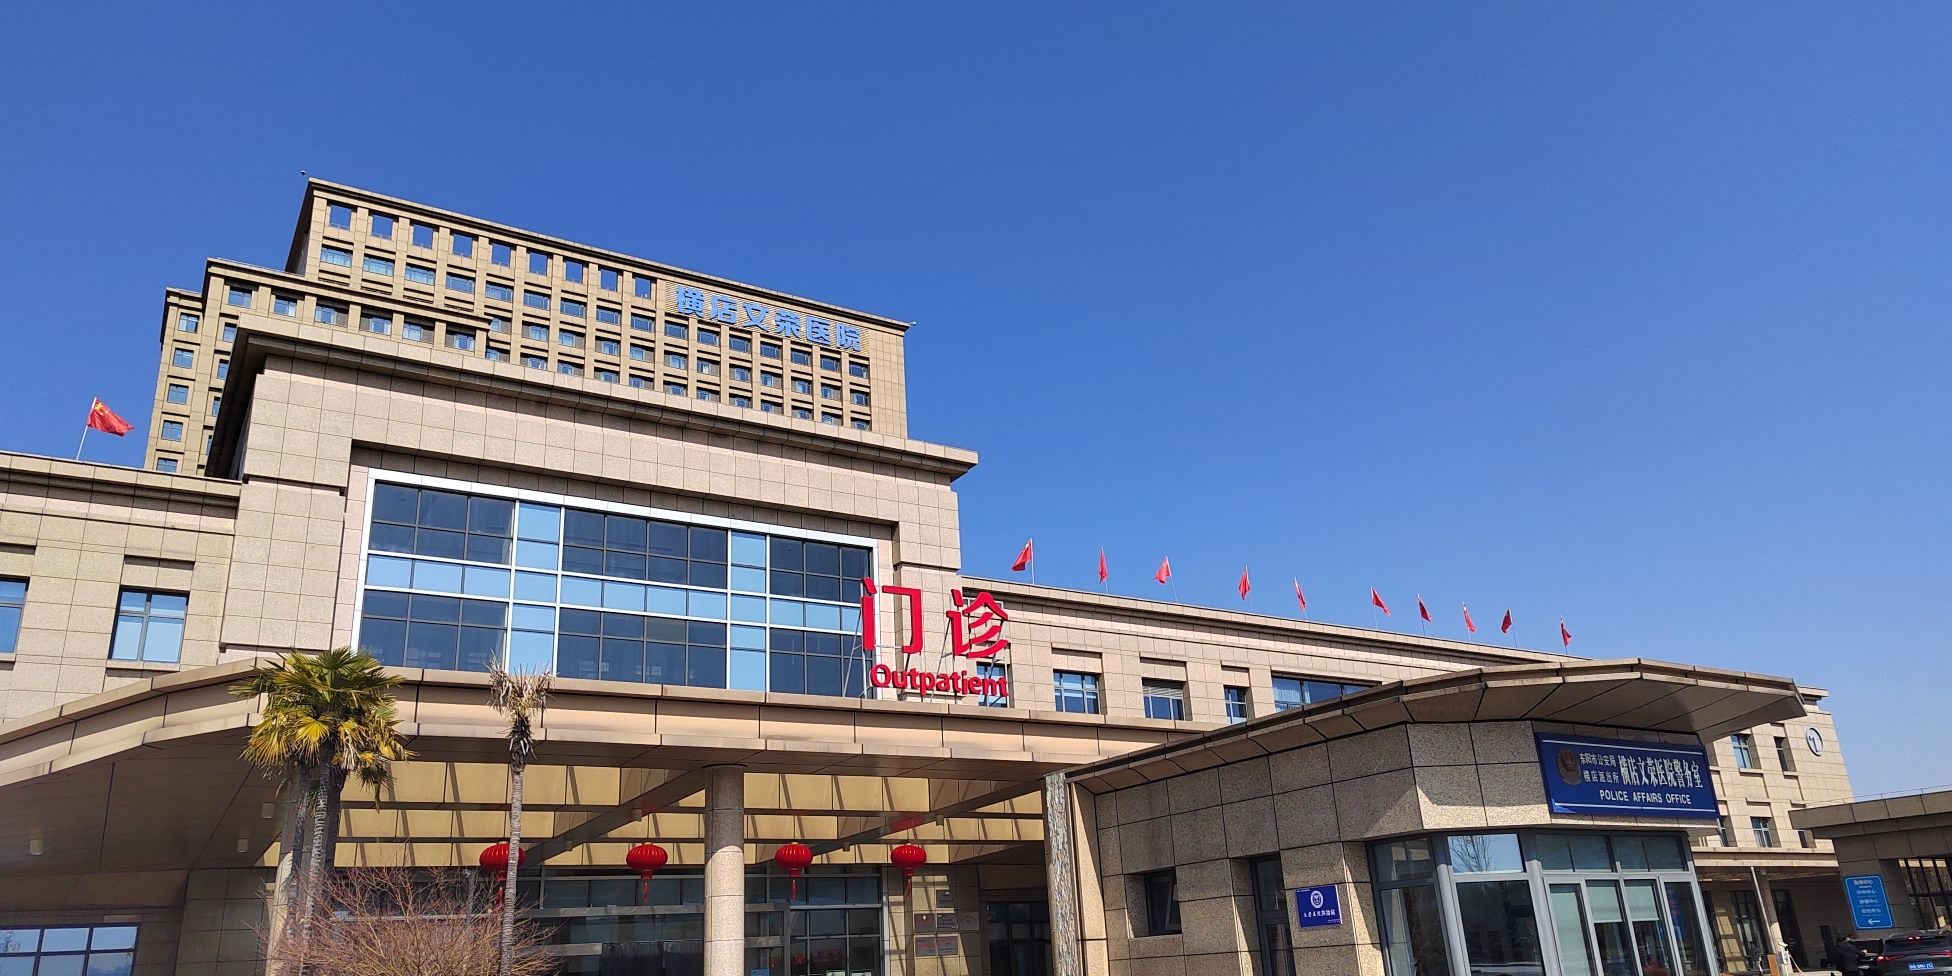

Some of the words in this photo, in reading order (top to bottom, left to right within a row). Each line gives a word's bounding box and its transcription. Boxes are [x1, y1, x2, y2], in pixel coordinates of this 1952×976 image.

[676, 284, 862, 352] 横店文荣医院
[861, 577, 1009, 659] 门诊
[870, 664, 1009, 698] Outpatient
[1618, 754, 1704, 788] 横店文荣医院警务室
[1599, 789, 1629, 802] POLICE
[1632, 791, 1663, 804] AFFAIRS
[1665, 793, 1692, 805] OFFICE
